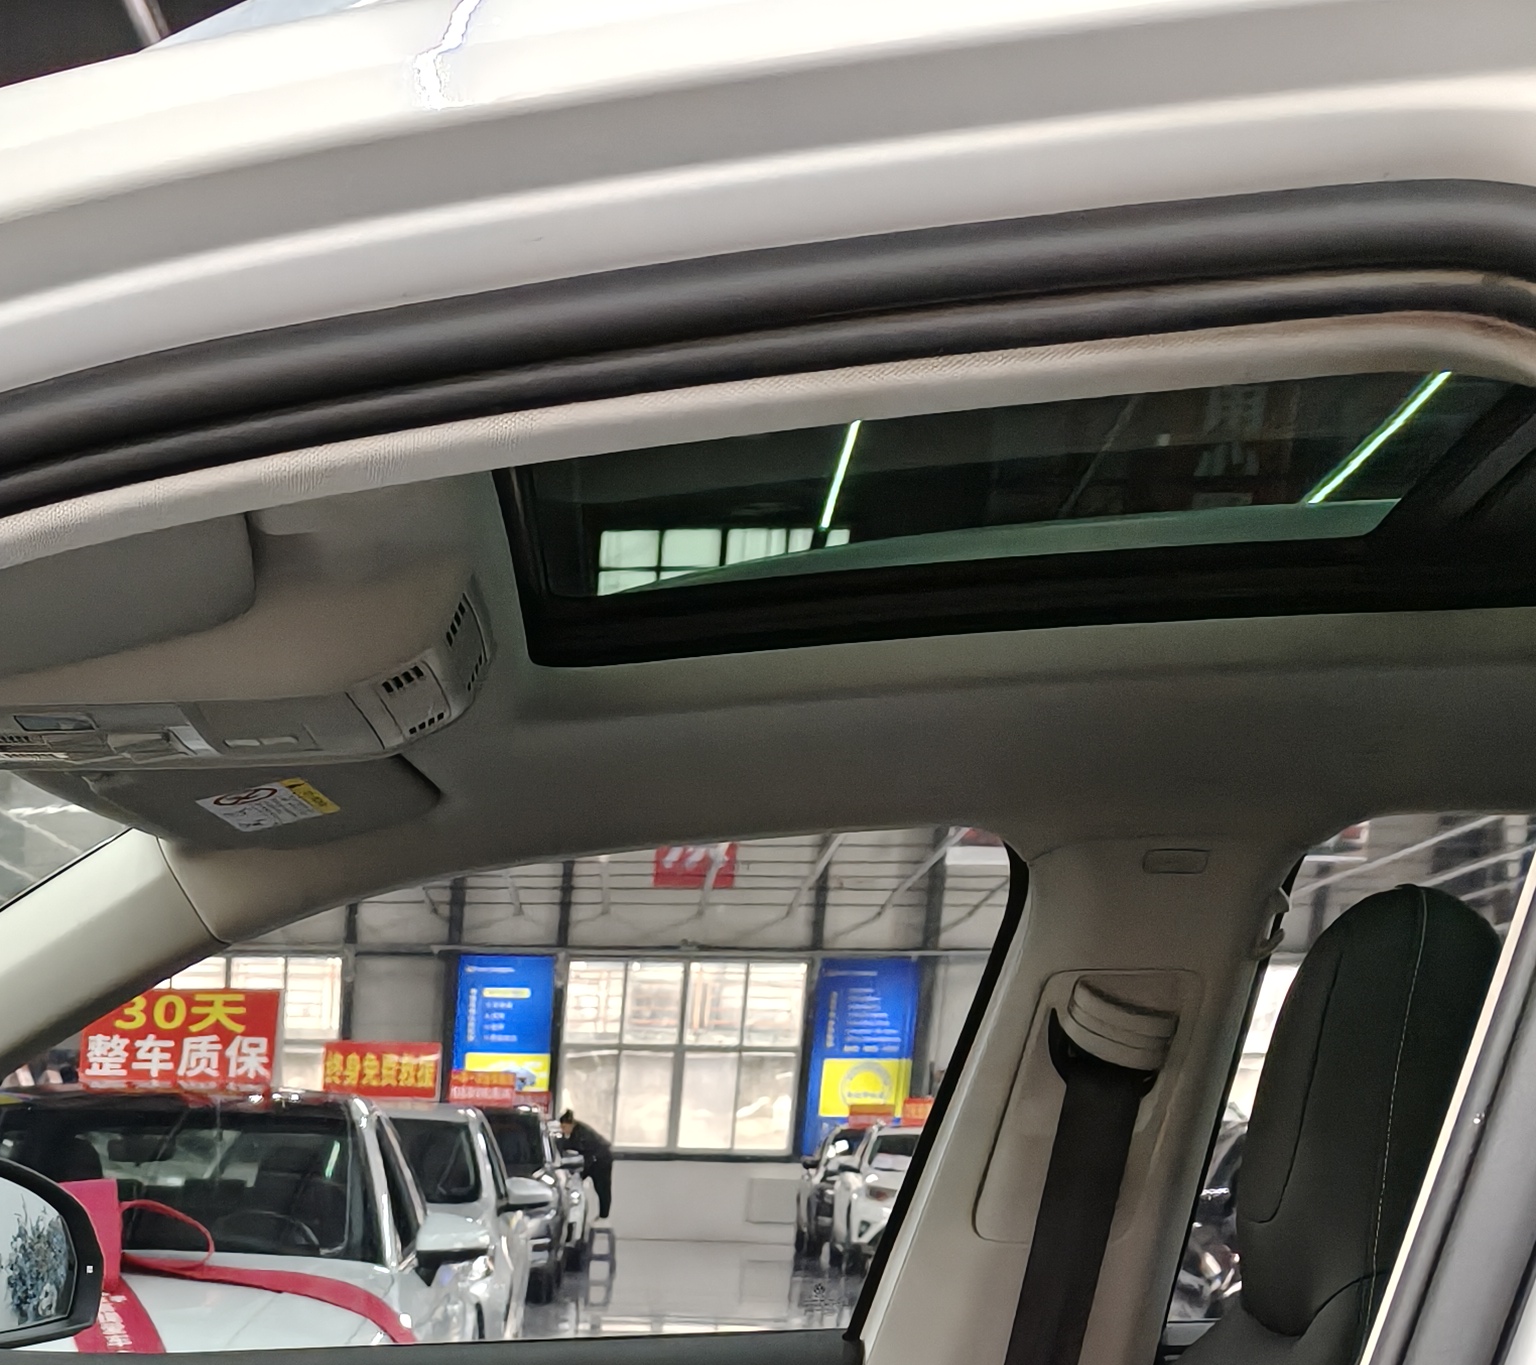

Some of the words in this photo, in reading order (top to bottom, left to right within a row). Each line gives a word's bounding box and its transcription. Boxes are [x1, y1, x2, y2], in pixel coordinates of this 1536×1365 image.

[115, 993, 247, 1033] 30天
[84, 1033, 271, 1079] 整车质保
